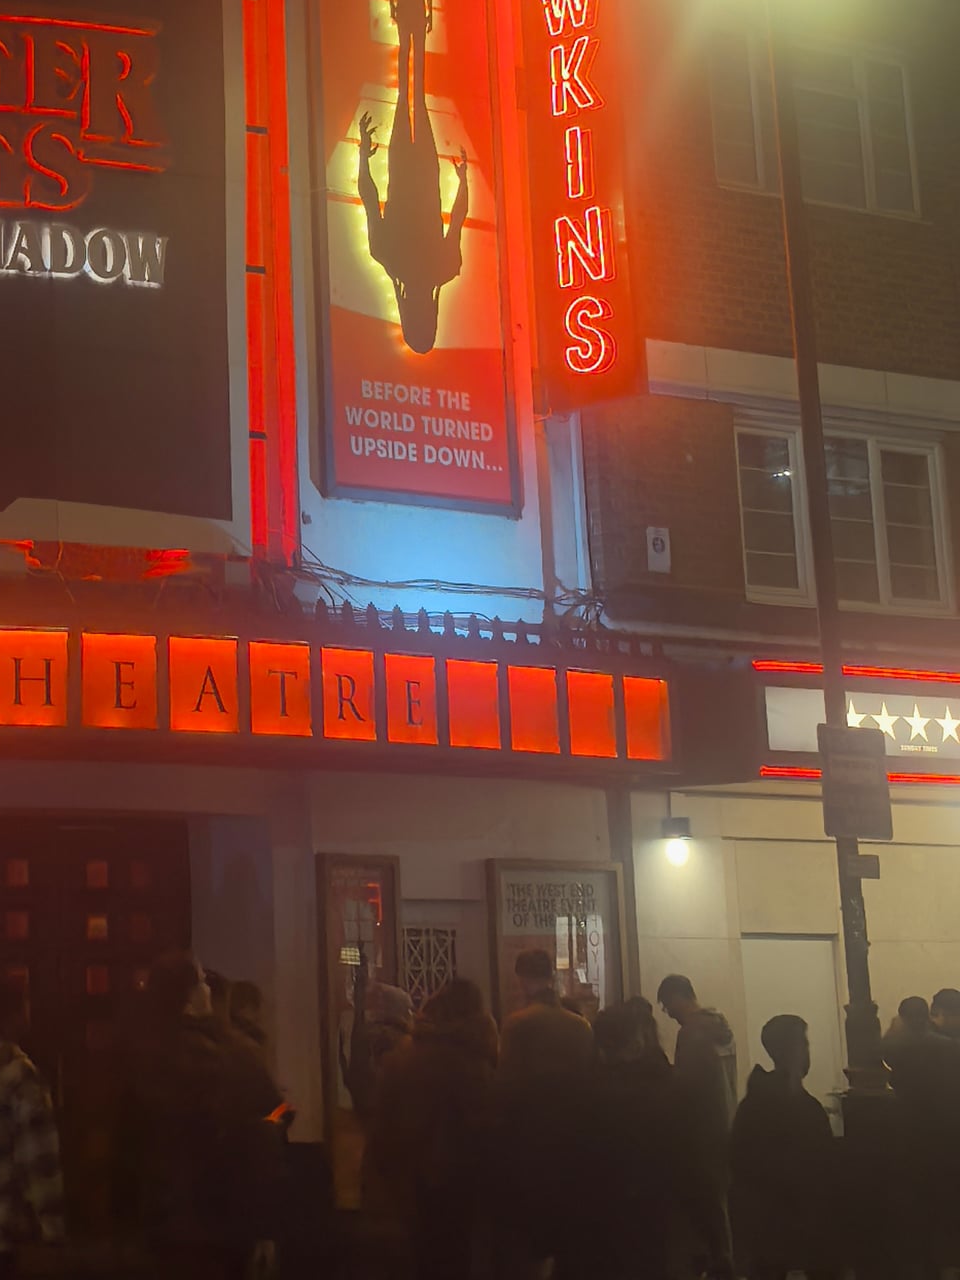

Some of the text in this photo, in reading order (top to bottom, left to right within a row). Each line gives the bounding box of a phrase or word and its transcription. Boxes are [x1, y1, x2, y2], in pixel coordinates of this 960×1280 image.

[361, 379, 472, 411] BEFORE THE
[344, 406, 494, 442] WORLD TURNED
[350, 435, 504, 471] UPSIDE DOWN...
[536, 882, 567, 898] WEST
[570, 882, 594, 898] END
[506, 897, 598, 913] THEATRE EVENT
[512, 912, 529, 928] OF
[533, 912, 555, 928] THE
